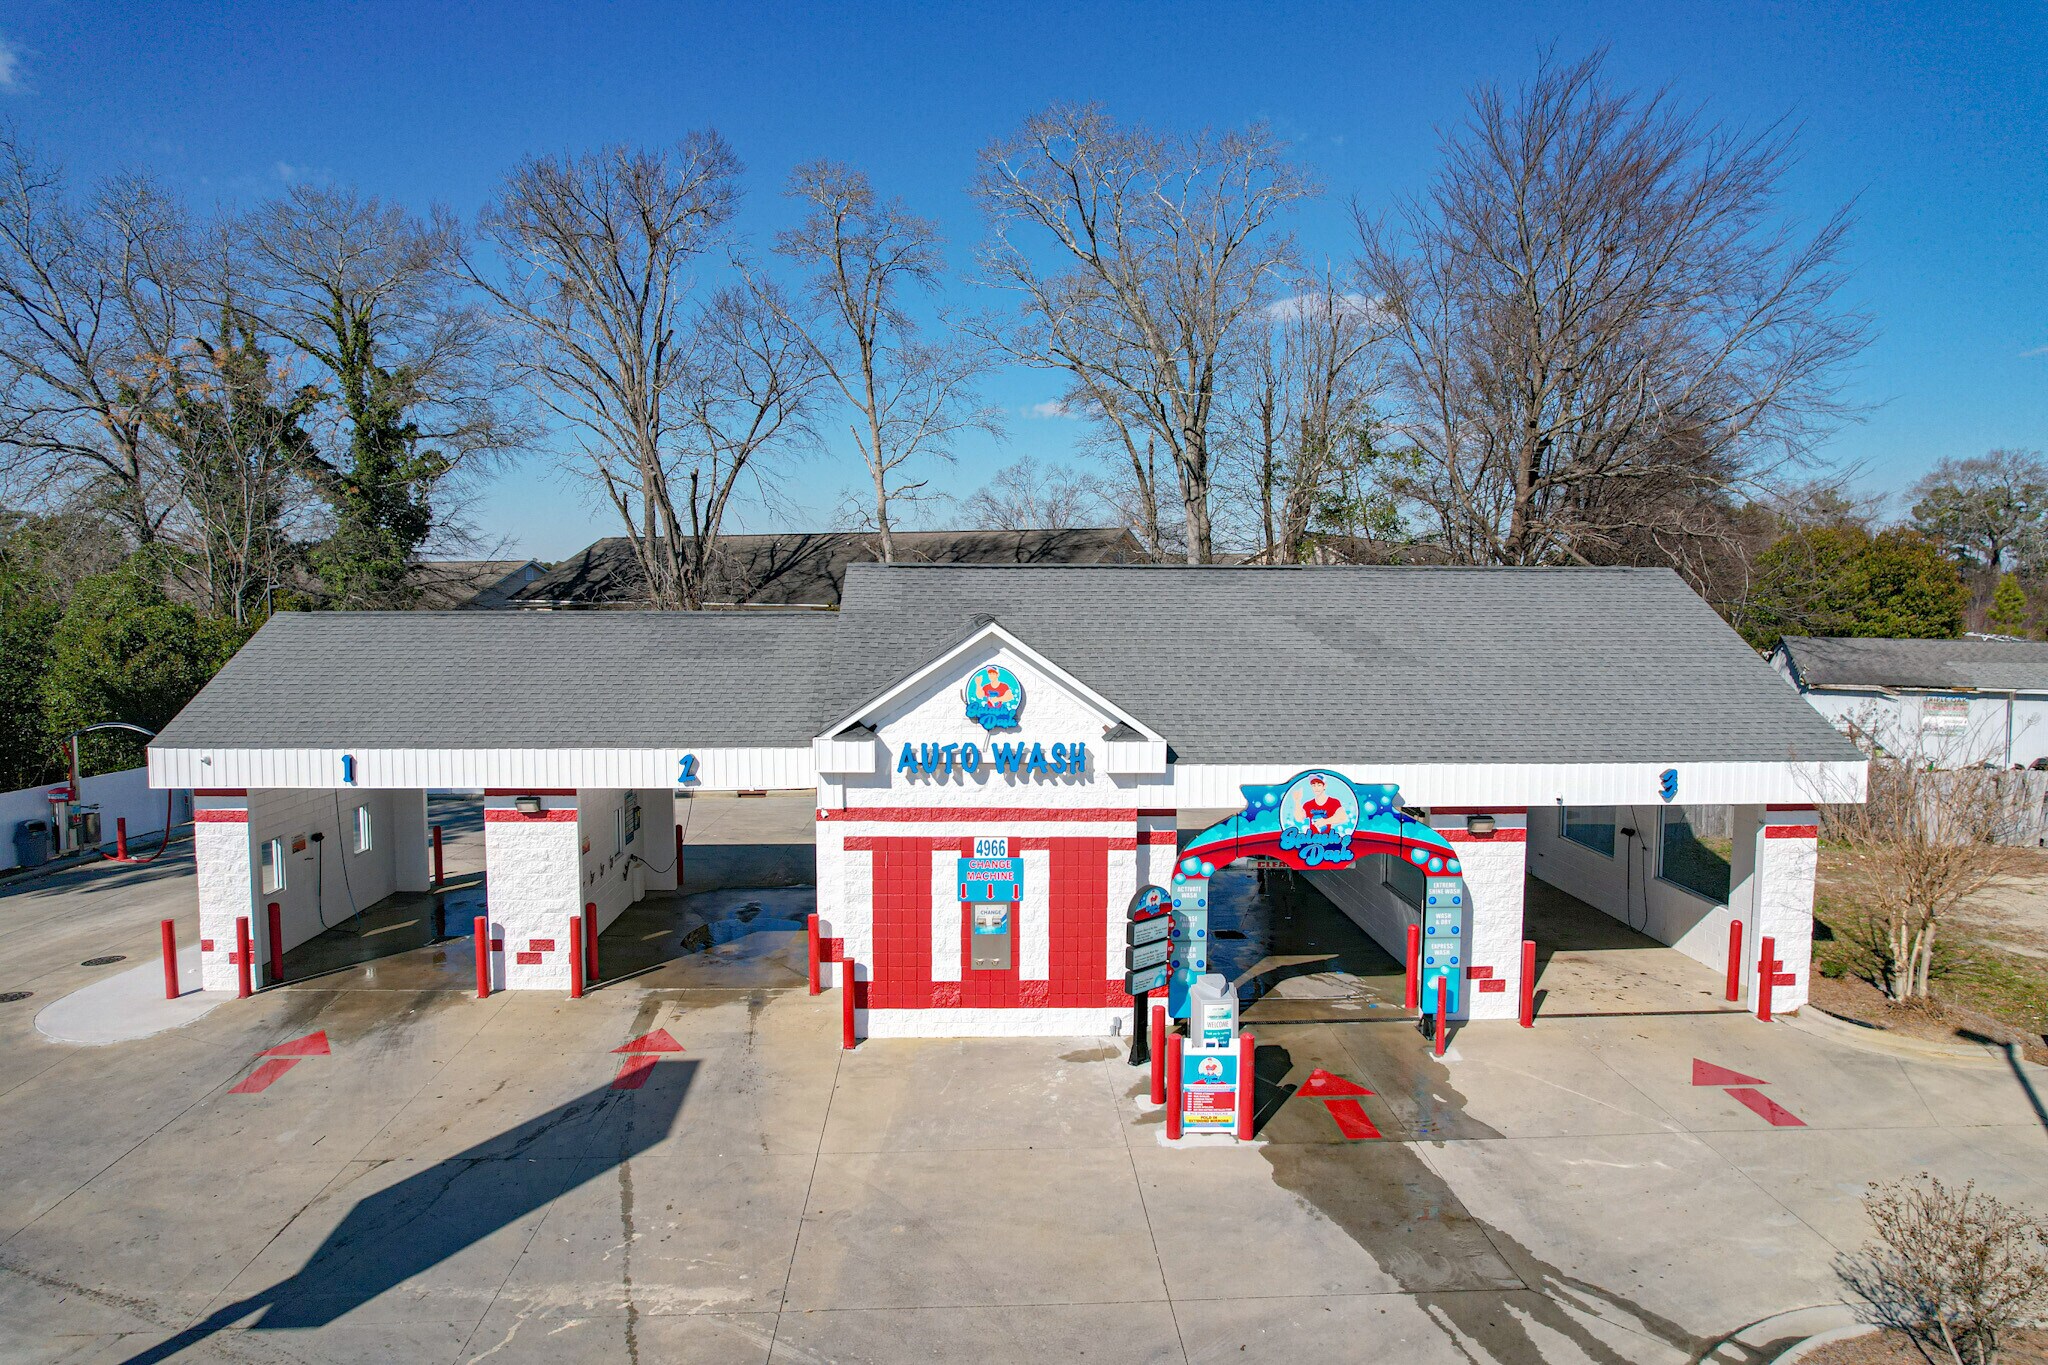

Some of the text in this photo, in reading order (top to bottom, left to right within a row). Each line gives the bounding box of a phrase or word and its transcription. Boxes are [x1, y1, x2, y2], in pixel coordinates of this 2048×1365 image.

[978, 713, 1018, 731] Dash
[342, 754, 353, 782] 1
[678, 754, 697, 782] 2
[897, 741, 1087, 775] AUTO WASH
[1660, 769, 1678, 799] 3
[976, 839, 1006, 856] 4966
[1279, 826, 1342, 851] Splash
[968, 859, 1012, 870] CHANGE
[1257, 861, 1291, 869] CLEA
[1298, 843, 1355, 867] Dash
[966, 871, 1015, 882] MACHINE
[1206, 1020, 1229, 1028] WELCOME
